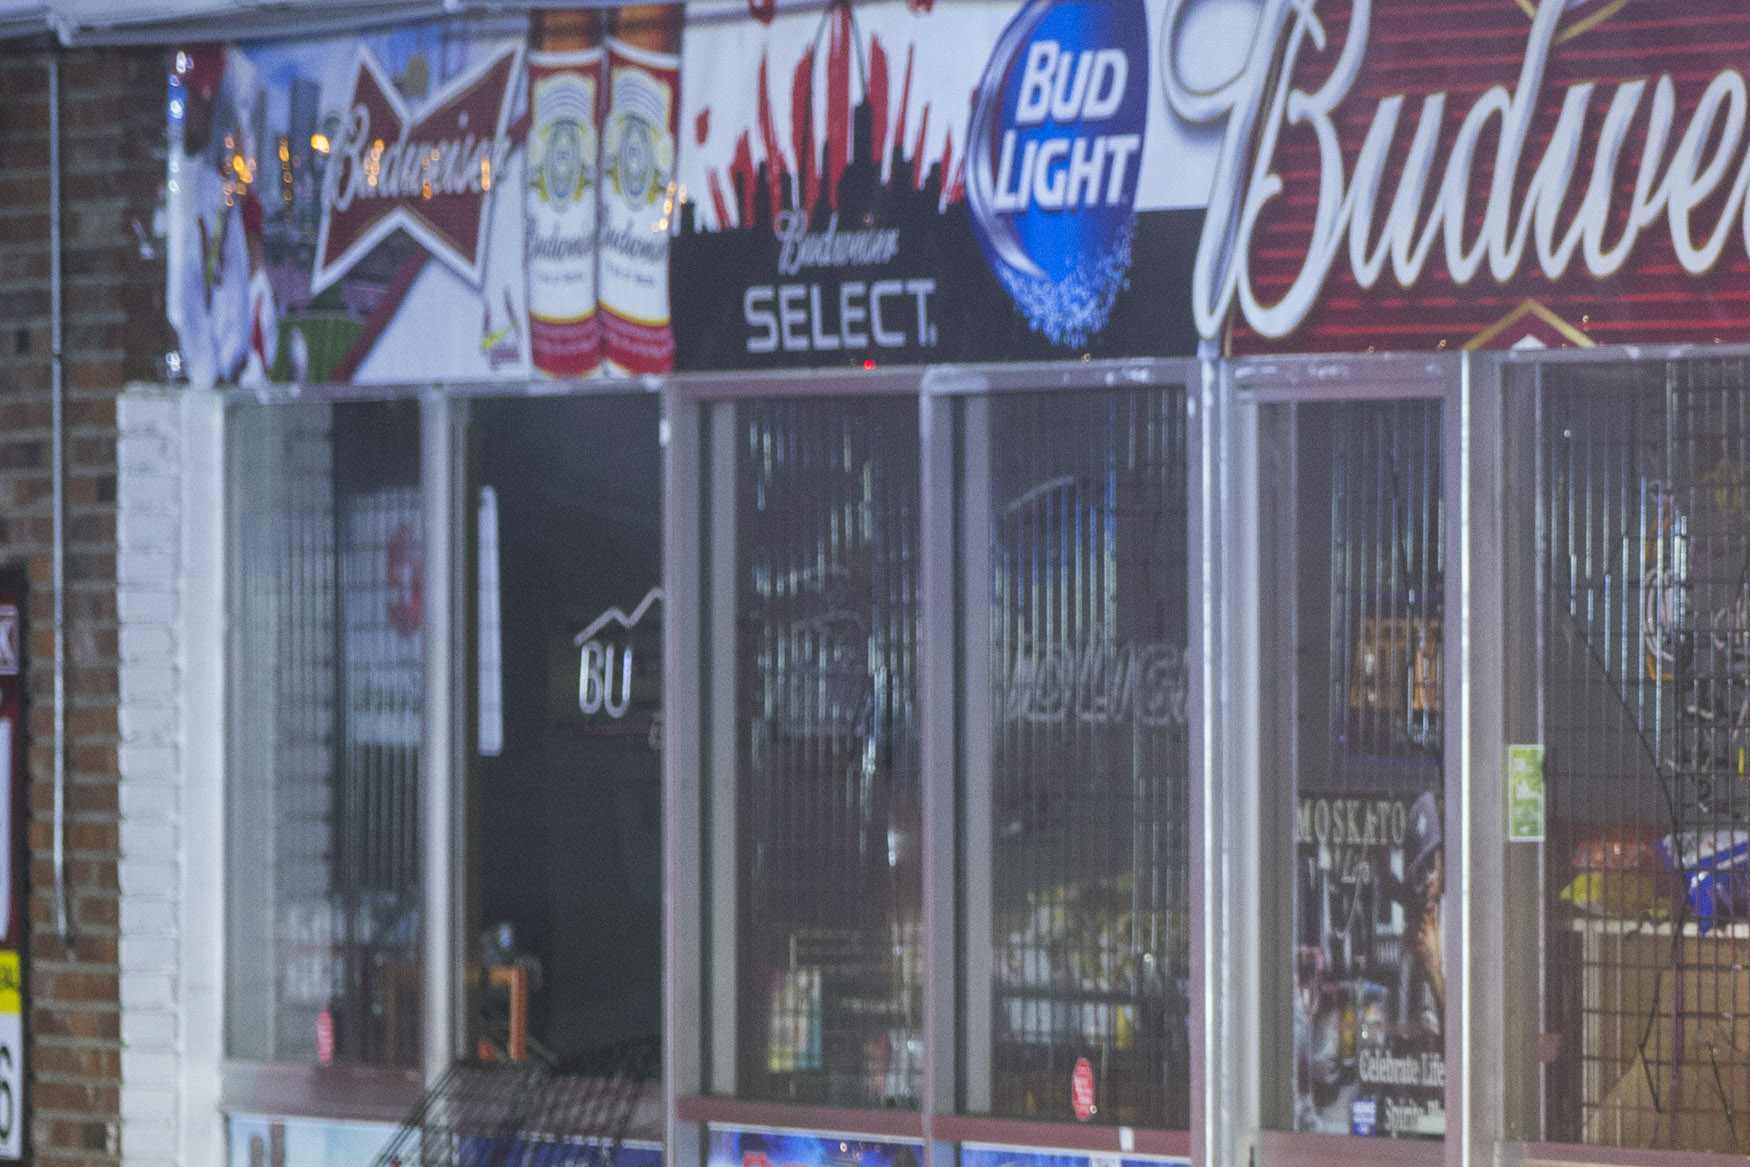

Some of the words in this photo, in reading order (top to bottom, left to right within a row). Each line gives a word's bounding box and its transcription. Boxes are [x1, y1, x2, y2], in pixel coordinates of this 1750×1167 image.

[1014, 40, 1129, 126] BUD
[996, 134, 1140, 212] LIGHT
[776, 210, 900, 275] Budweiser
[745, 279, 936, 353] SELECT
